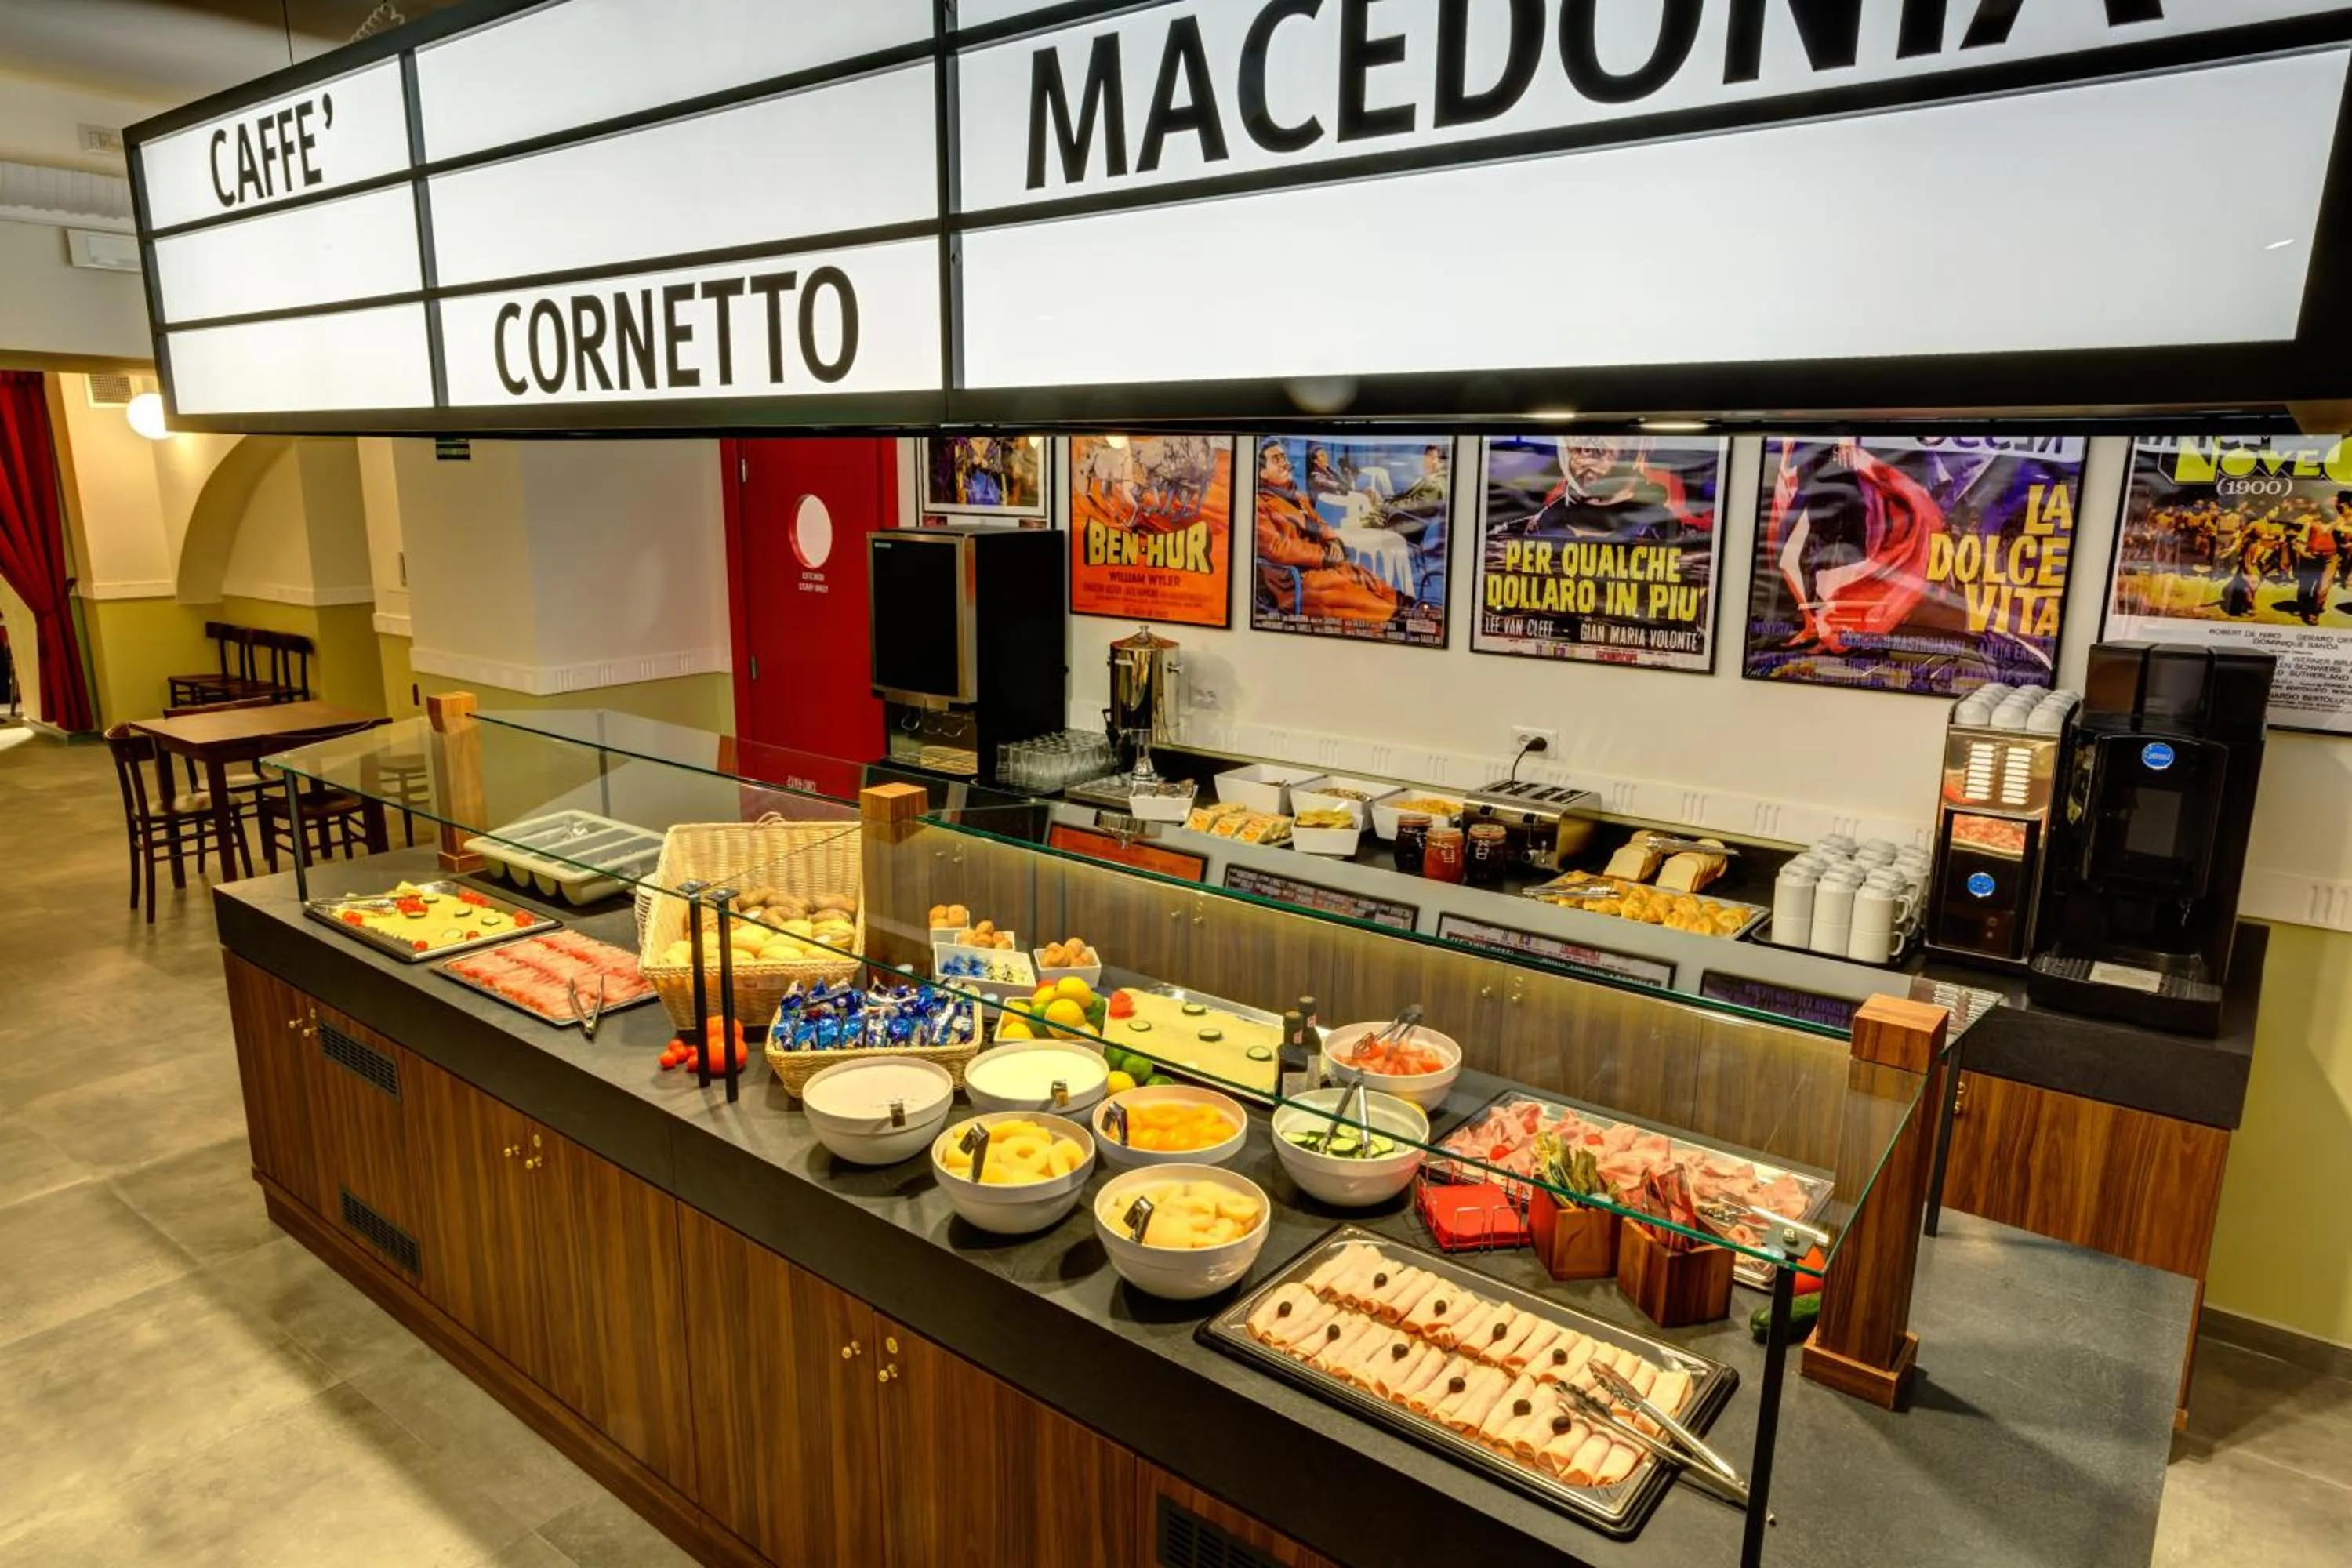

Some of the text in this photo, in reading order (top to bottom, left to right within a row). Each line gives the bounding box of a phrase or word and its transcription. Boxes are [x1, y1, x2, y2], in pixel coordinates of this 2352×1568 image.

[1026, 0, 2165, 190] MACEDO
[210, 92, 333, 207] CAFFE'
[494, 266, 859, 396] CORNETTO
[2024, 484, 2073, 535] LA
[2216, 478, 2293, 497] (1900)
[1087, 517, 1213, 575] BEN-HUR
[1504, 539, 1682, 583] PER QUALCHE
[1926, 532, 2071, 586] DOLCE
[1108, 570, 1181, 586] WILLIAM WYLER
[1486, 573, 1596, 614] DOLLARO
[1605, 581, 1638, 617] IN
[1485, 617, 1500, 634] LEE
[1504, 619, 1523, 636] VAN
[1526, 619, 1554, 637] CLEEF
[1579, 623, 1606, 641] GIAN
[1610, 626, 1646, 647] MARIA
[1965, 583, 2064, 637] VITA
